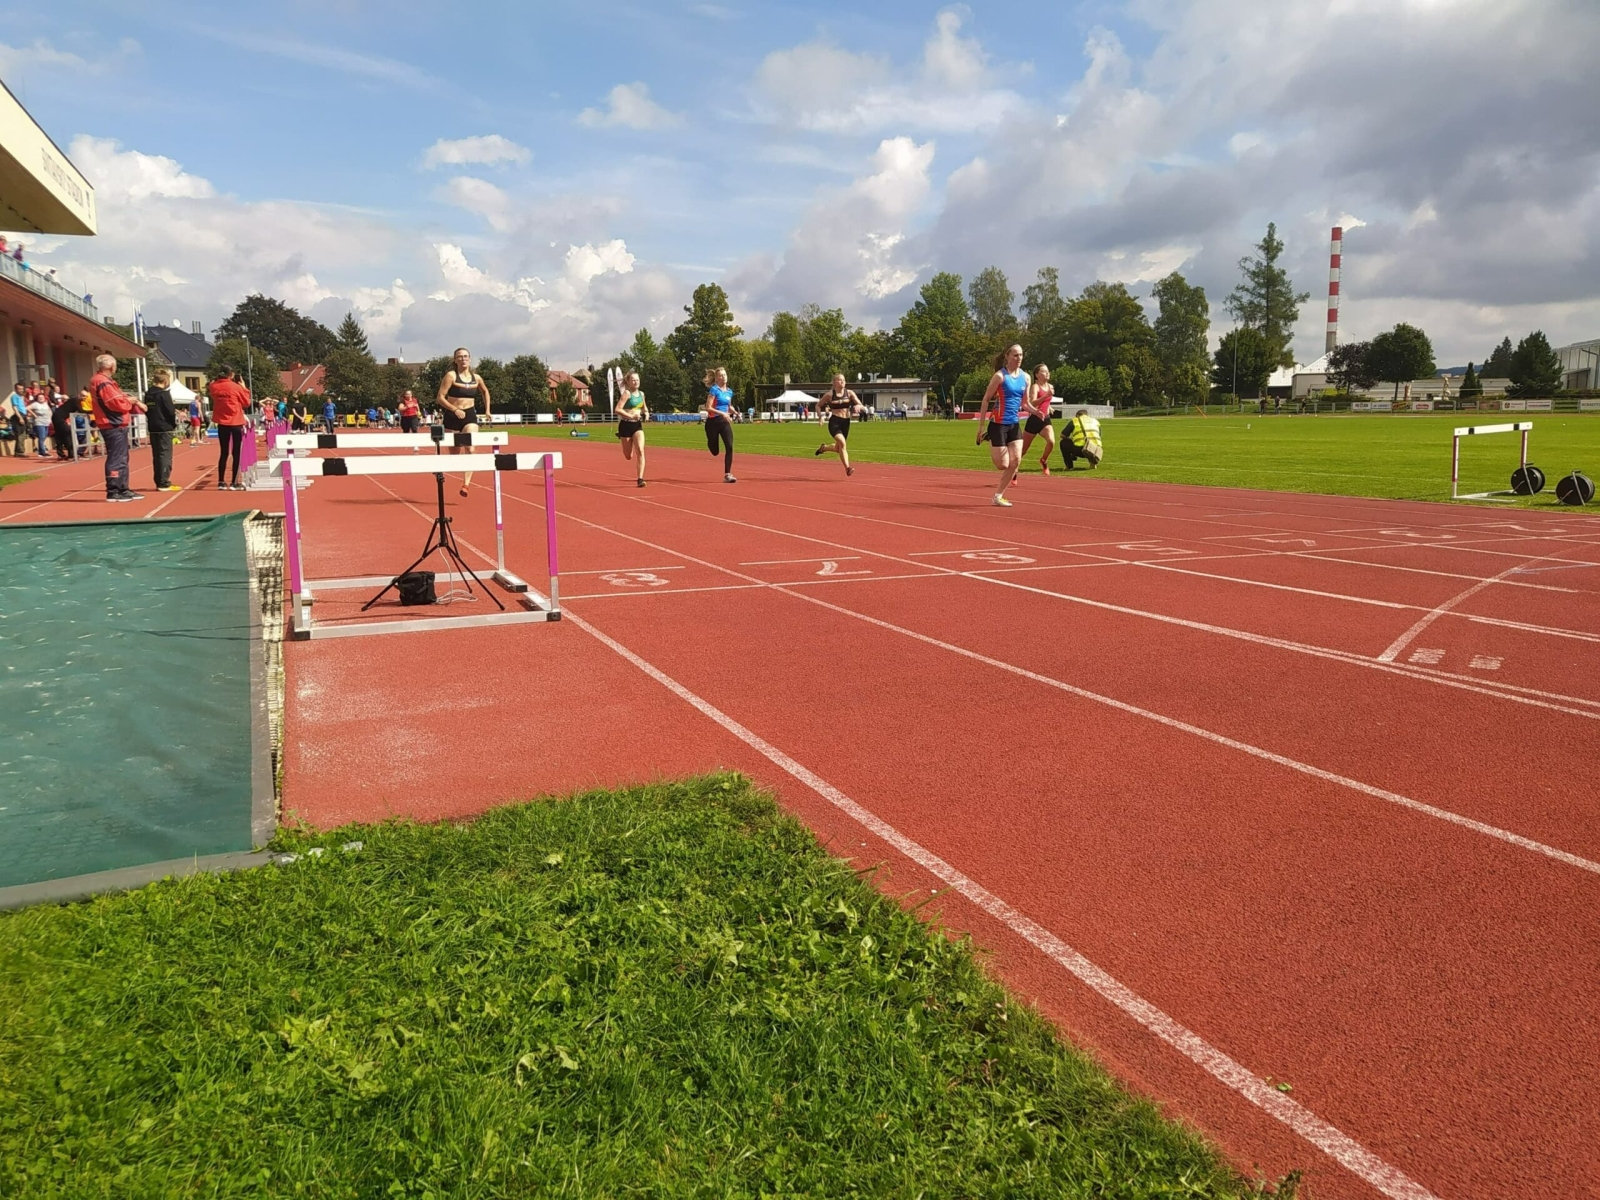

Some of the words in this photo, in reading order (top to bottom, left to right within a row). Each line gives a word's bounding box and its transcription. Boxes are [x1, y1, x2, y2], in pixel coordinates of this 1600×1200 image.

[1116, 544, 1202, 556] 5
[816, 560, 874, 576] 7
[598, 572, 670, 587] 8
